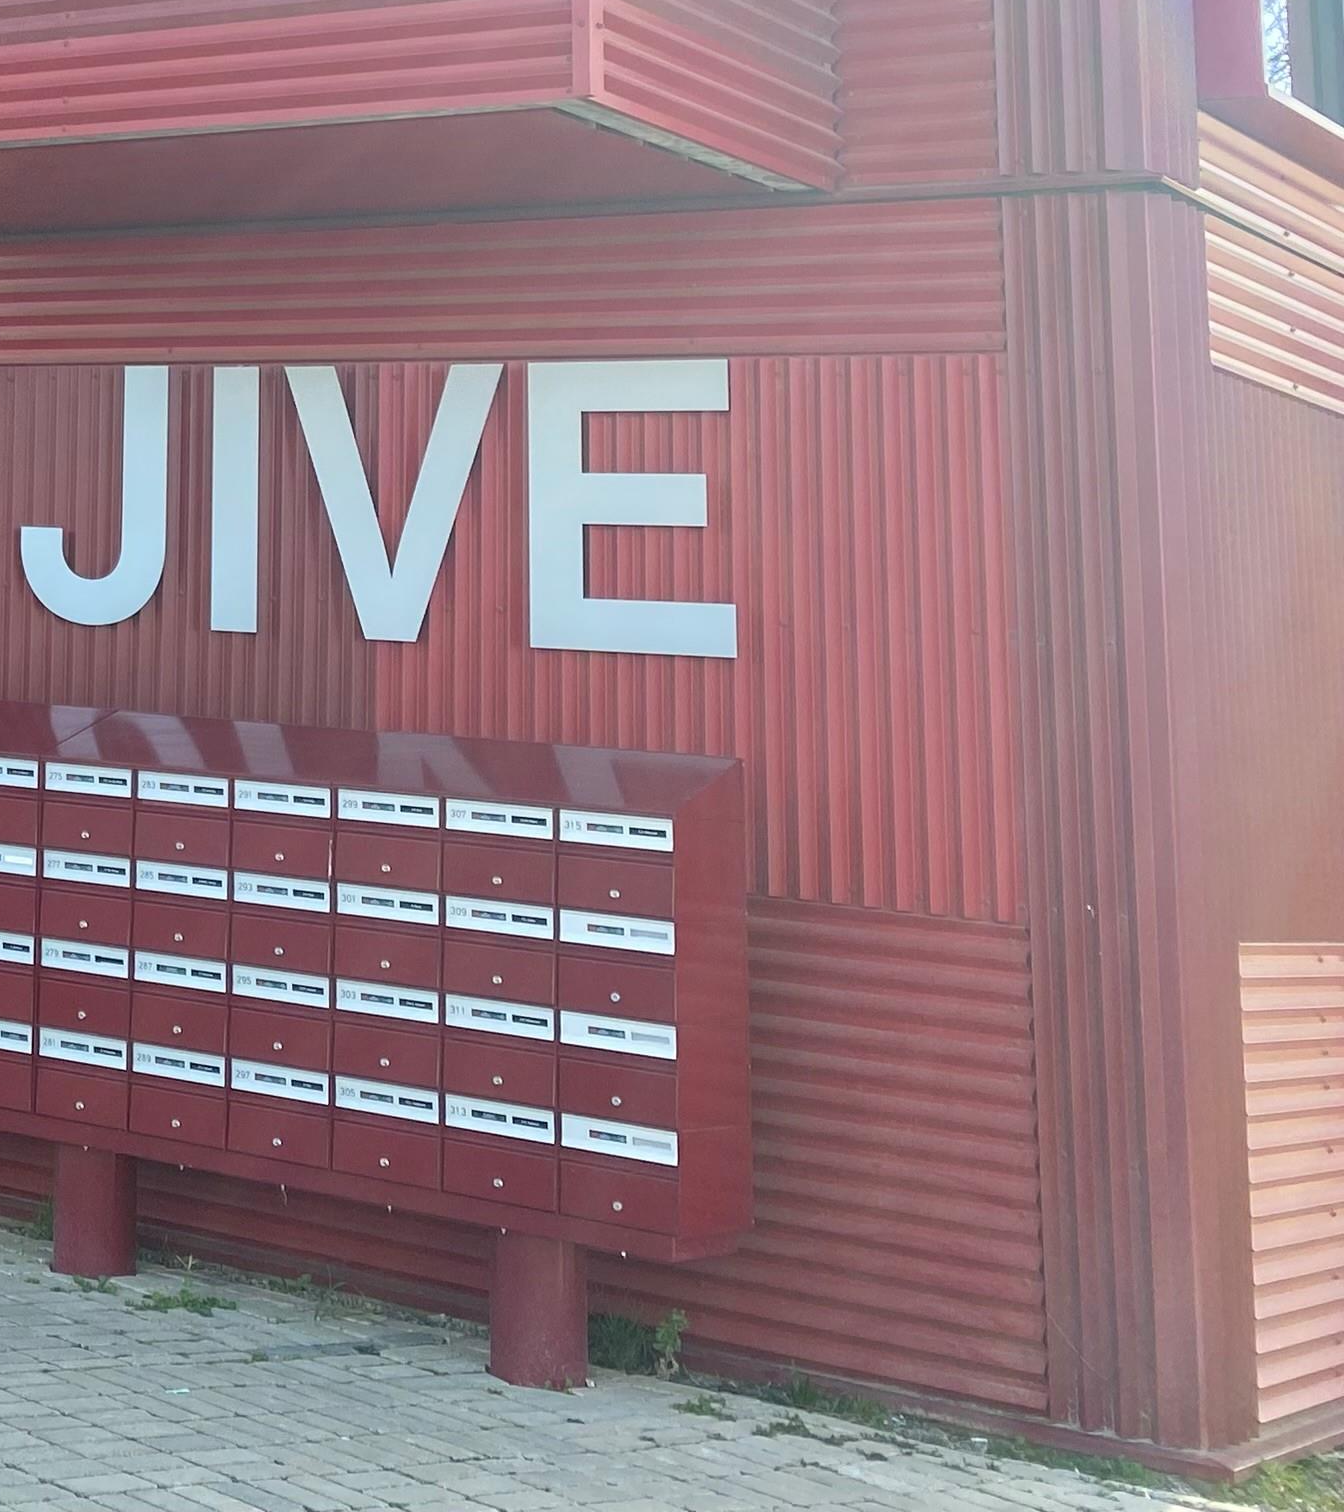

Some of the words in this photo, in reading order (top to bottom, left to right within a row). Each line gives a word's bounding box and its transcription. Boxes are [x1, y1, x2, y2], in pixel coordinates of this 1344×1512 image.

[21, 360, 738, 659] JIVE
[49, 772, 63, 781] 275
[142, 780, 156, 790] 283
[238, 790, 252, 799] 291
[343, 800, 358, 809] 299
[451, 809, 467, 819] 307
[564, 820, 582, 830] 315
[48, 860, 61, 869] 277
[140, 870, 154, 879] 285
[238, 882, 253, 892] 293
[341, 894, 356, 904] 301
[450, 906, 467, 917] 309
[46, 948, 59, 958] 279
[139, 961, 153, 970] 287
[237, 976, 252, 986] 295
[341, 989, 356, 1000] 303
[450, 1005, 466, 1016] 311
[44, 1038, 56, 1047] 281
[137, 1053, 152, 1063] 289
[236, 1069, 251, 1080] 297
[340, 1087, 356, 1098] 305
[450, 1105, 467, 1117] 313
